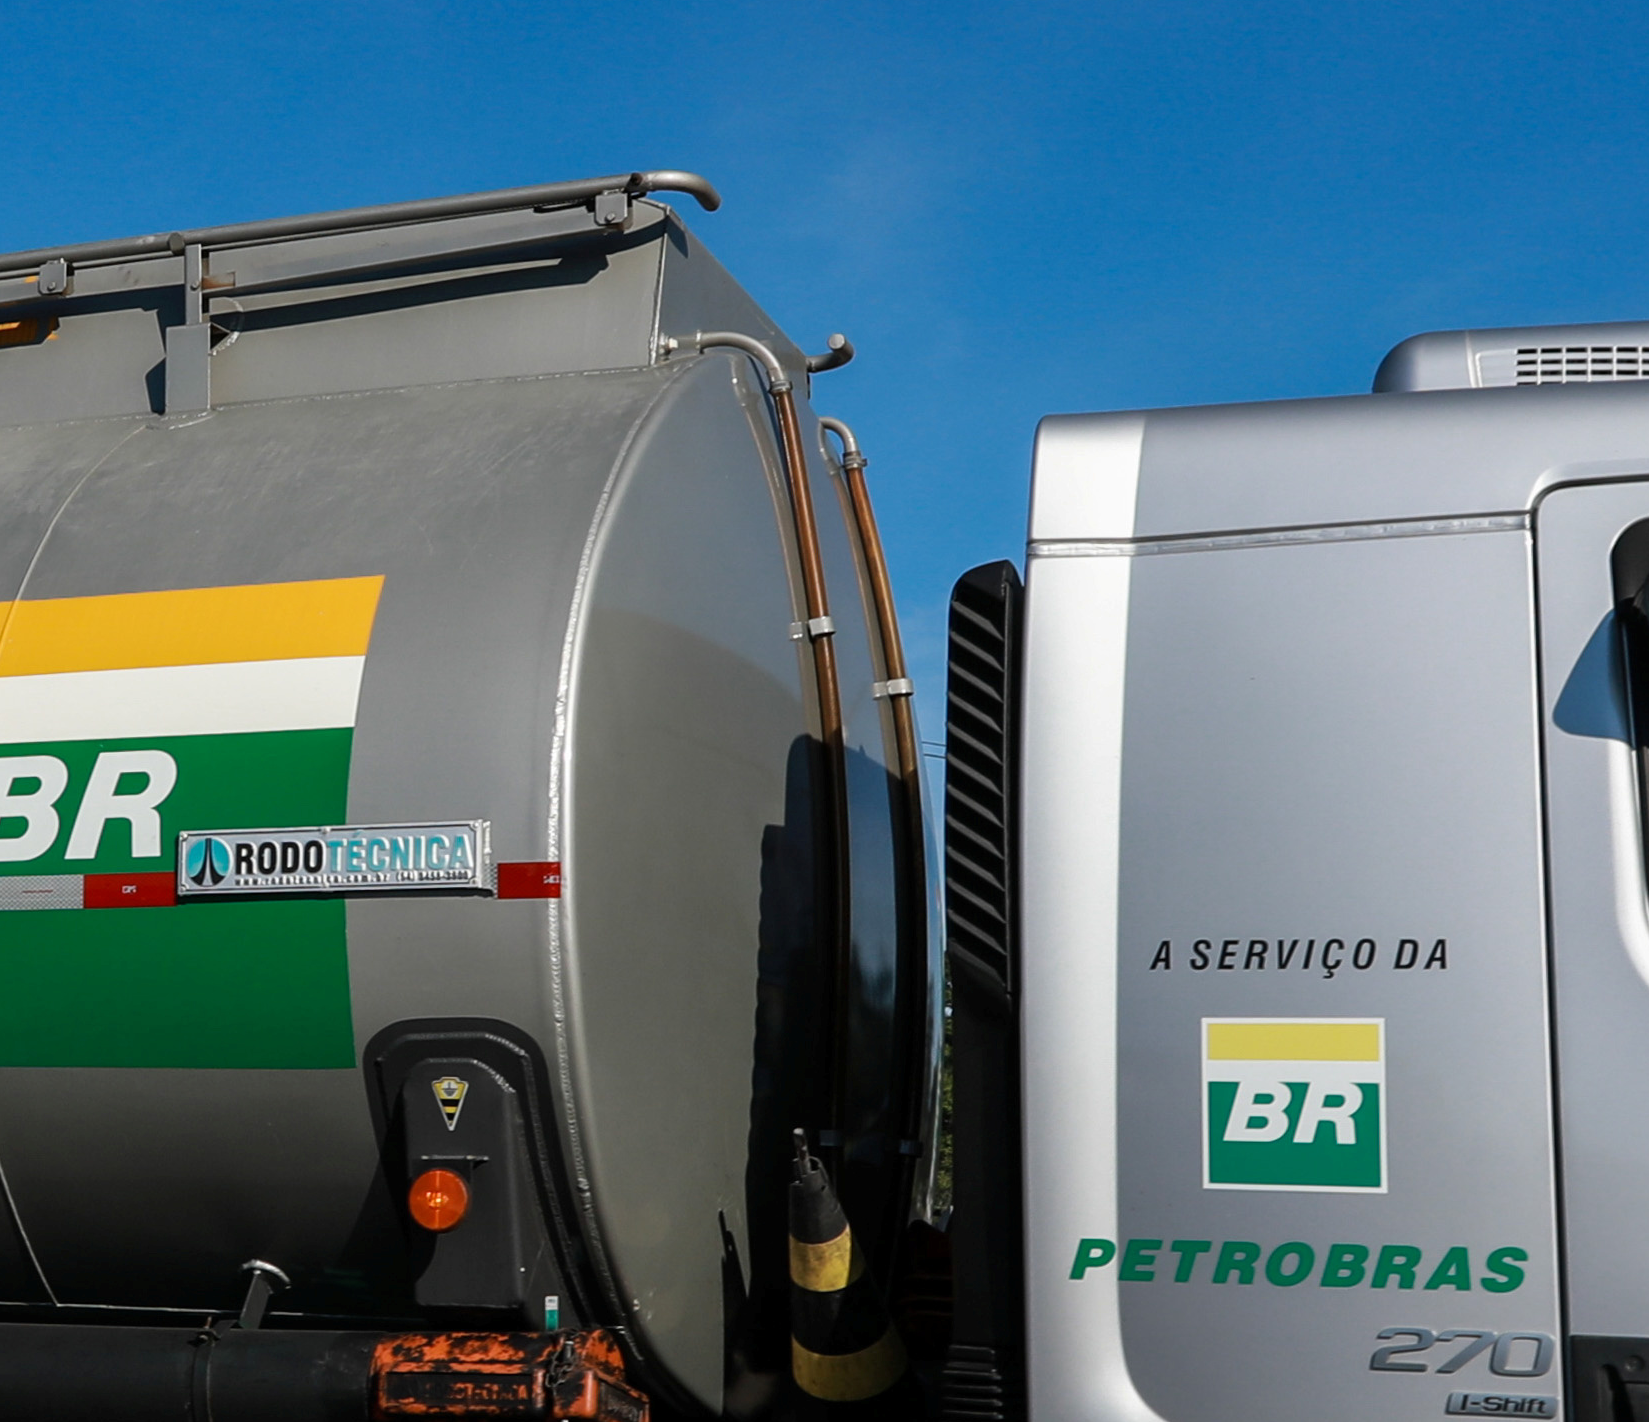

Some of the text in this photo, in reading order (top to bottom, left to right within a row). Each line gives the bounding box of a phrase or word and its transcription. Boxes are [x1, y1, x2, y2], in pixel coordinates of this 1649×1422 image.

[235, 830, 473, 875] RODOTÉCNICA
[1149, 938, 1449, 979] A SERVIÇO DA
[1223, 1079, 1364, 1145] BR
[1068, 1238, 1529, 1294] PETROBRAS
[1369, 1327, 1556, 1378] 270
[1460, 1394, 1547, 1414] I-Shift
